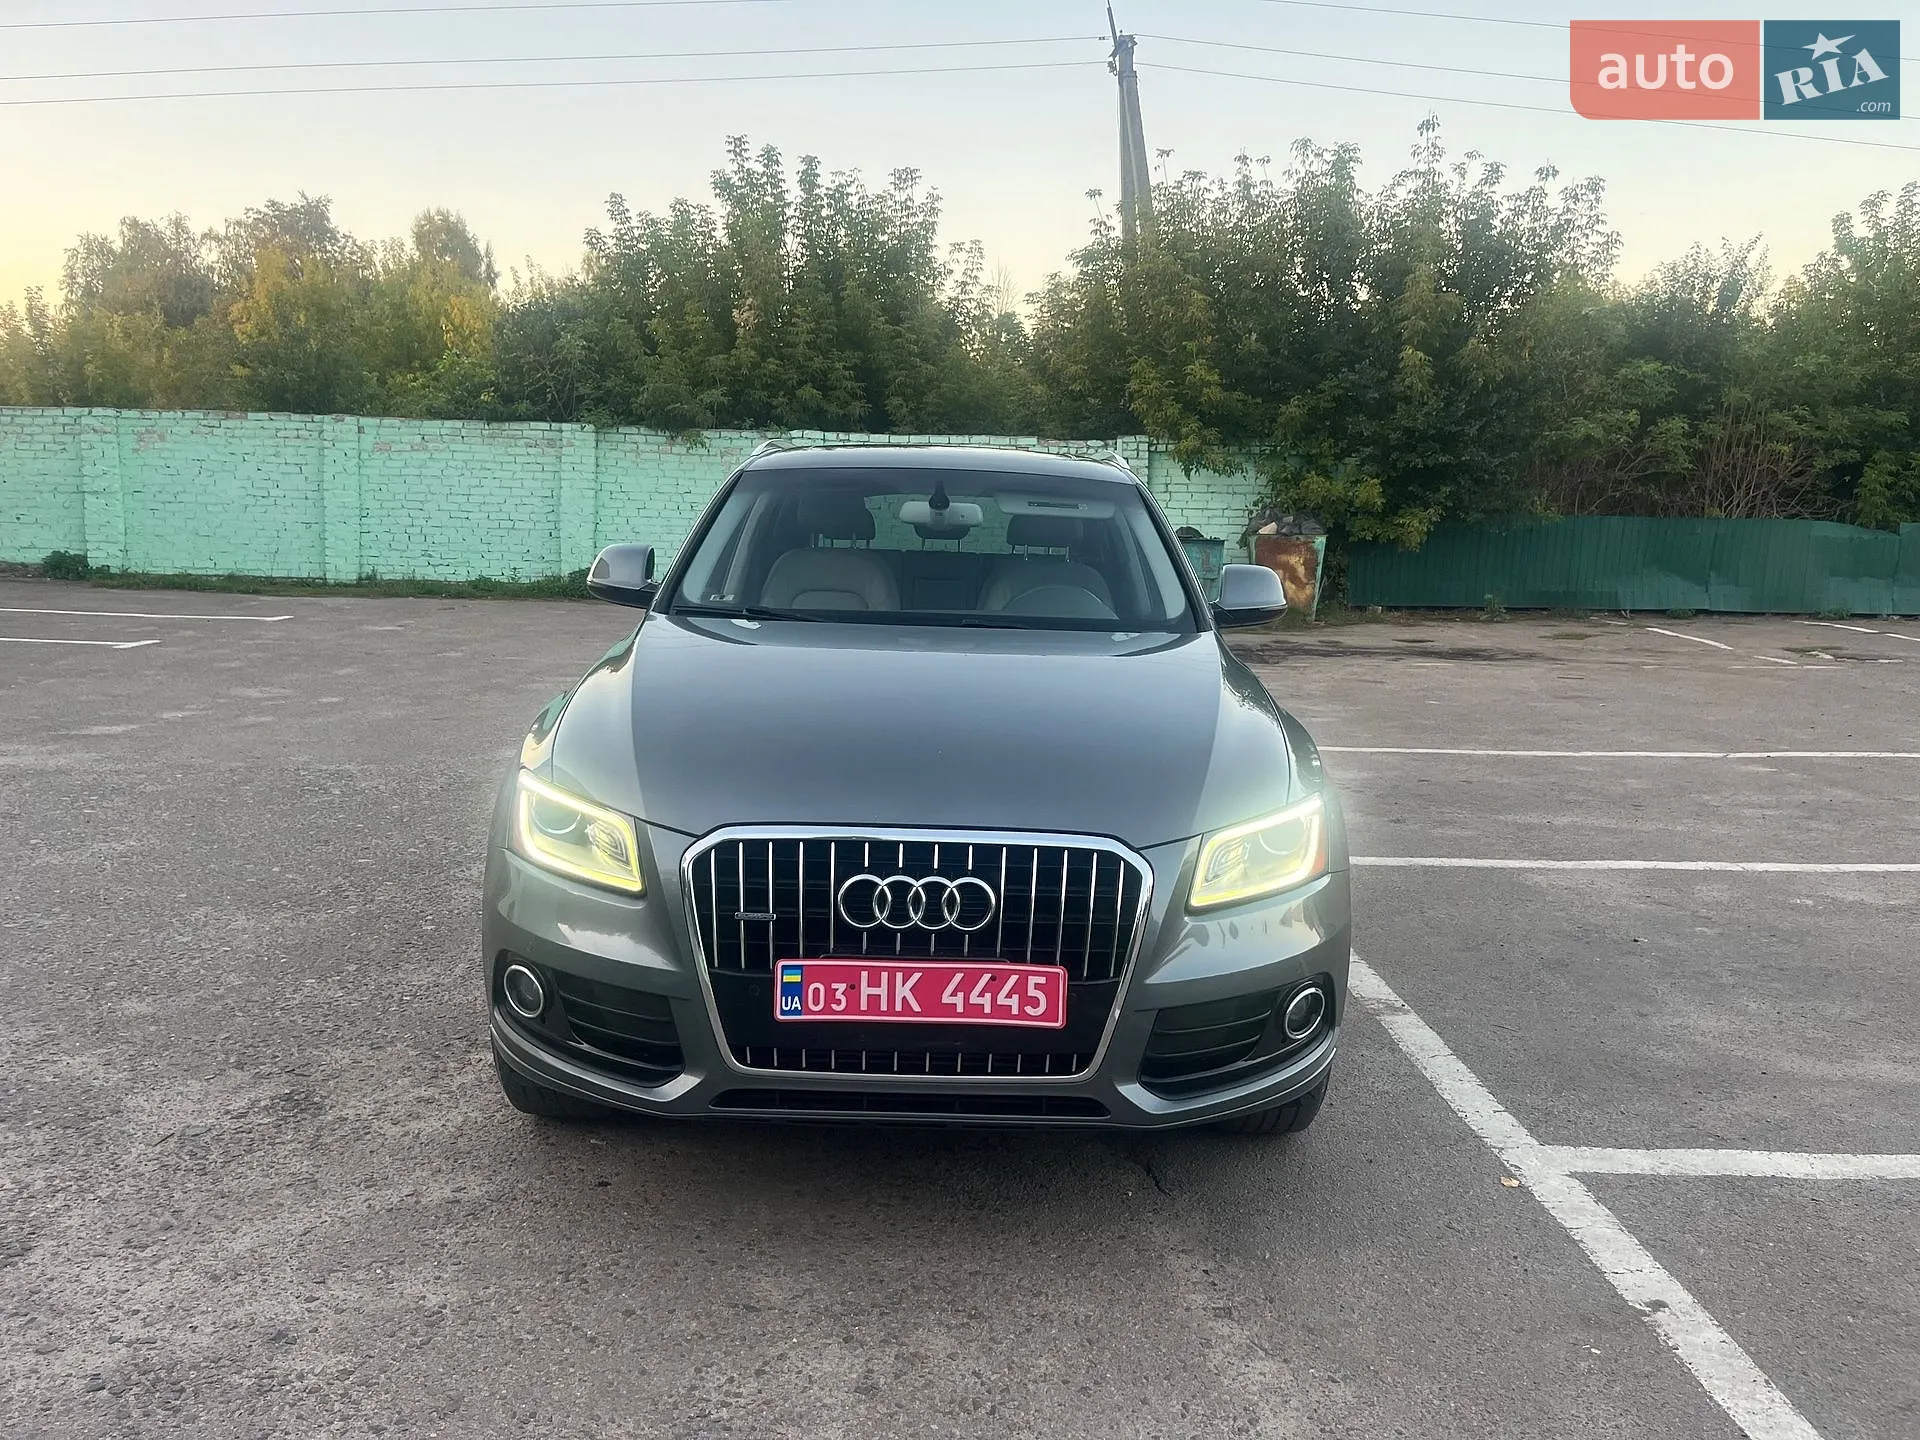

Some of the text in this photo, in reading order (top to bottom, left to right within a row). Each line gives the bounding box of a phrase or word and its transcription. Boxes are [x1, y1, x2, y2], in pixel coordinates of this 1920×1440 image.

[781, 995, 802, 1011] UA
[807, 970, 1047, 1016] 03 HK 4445
